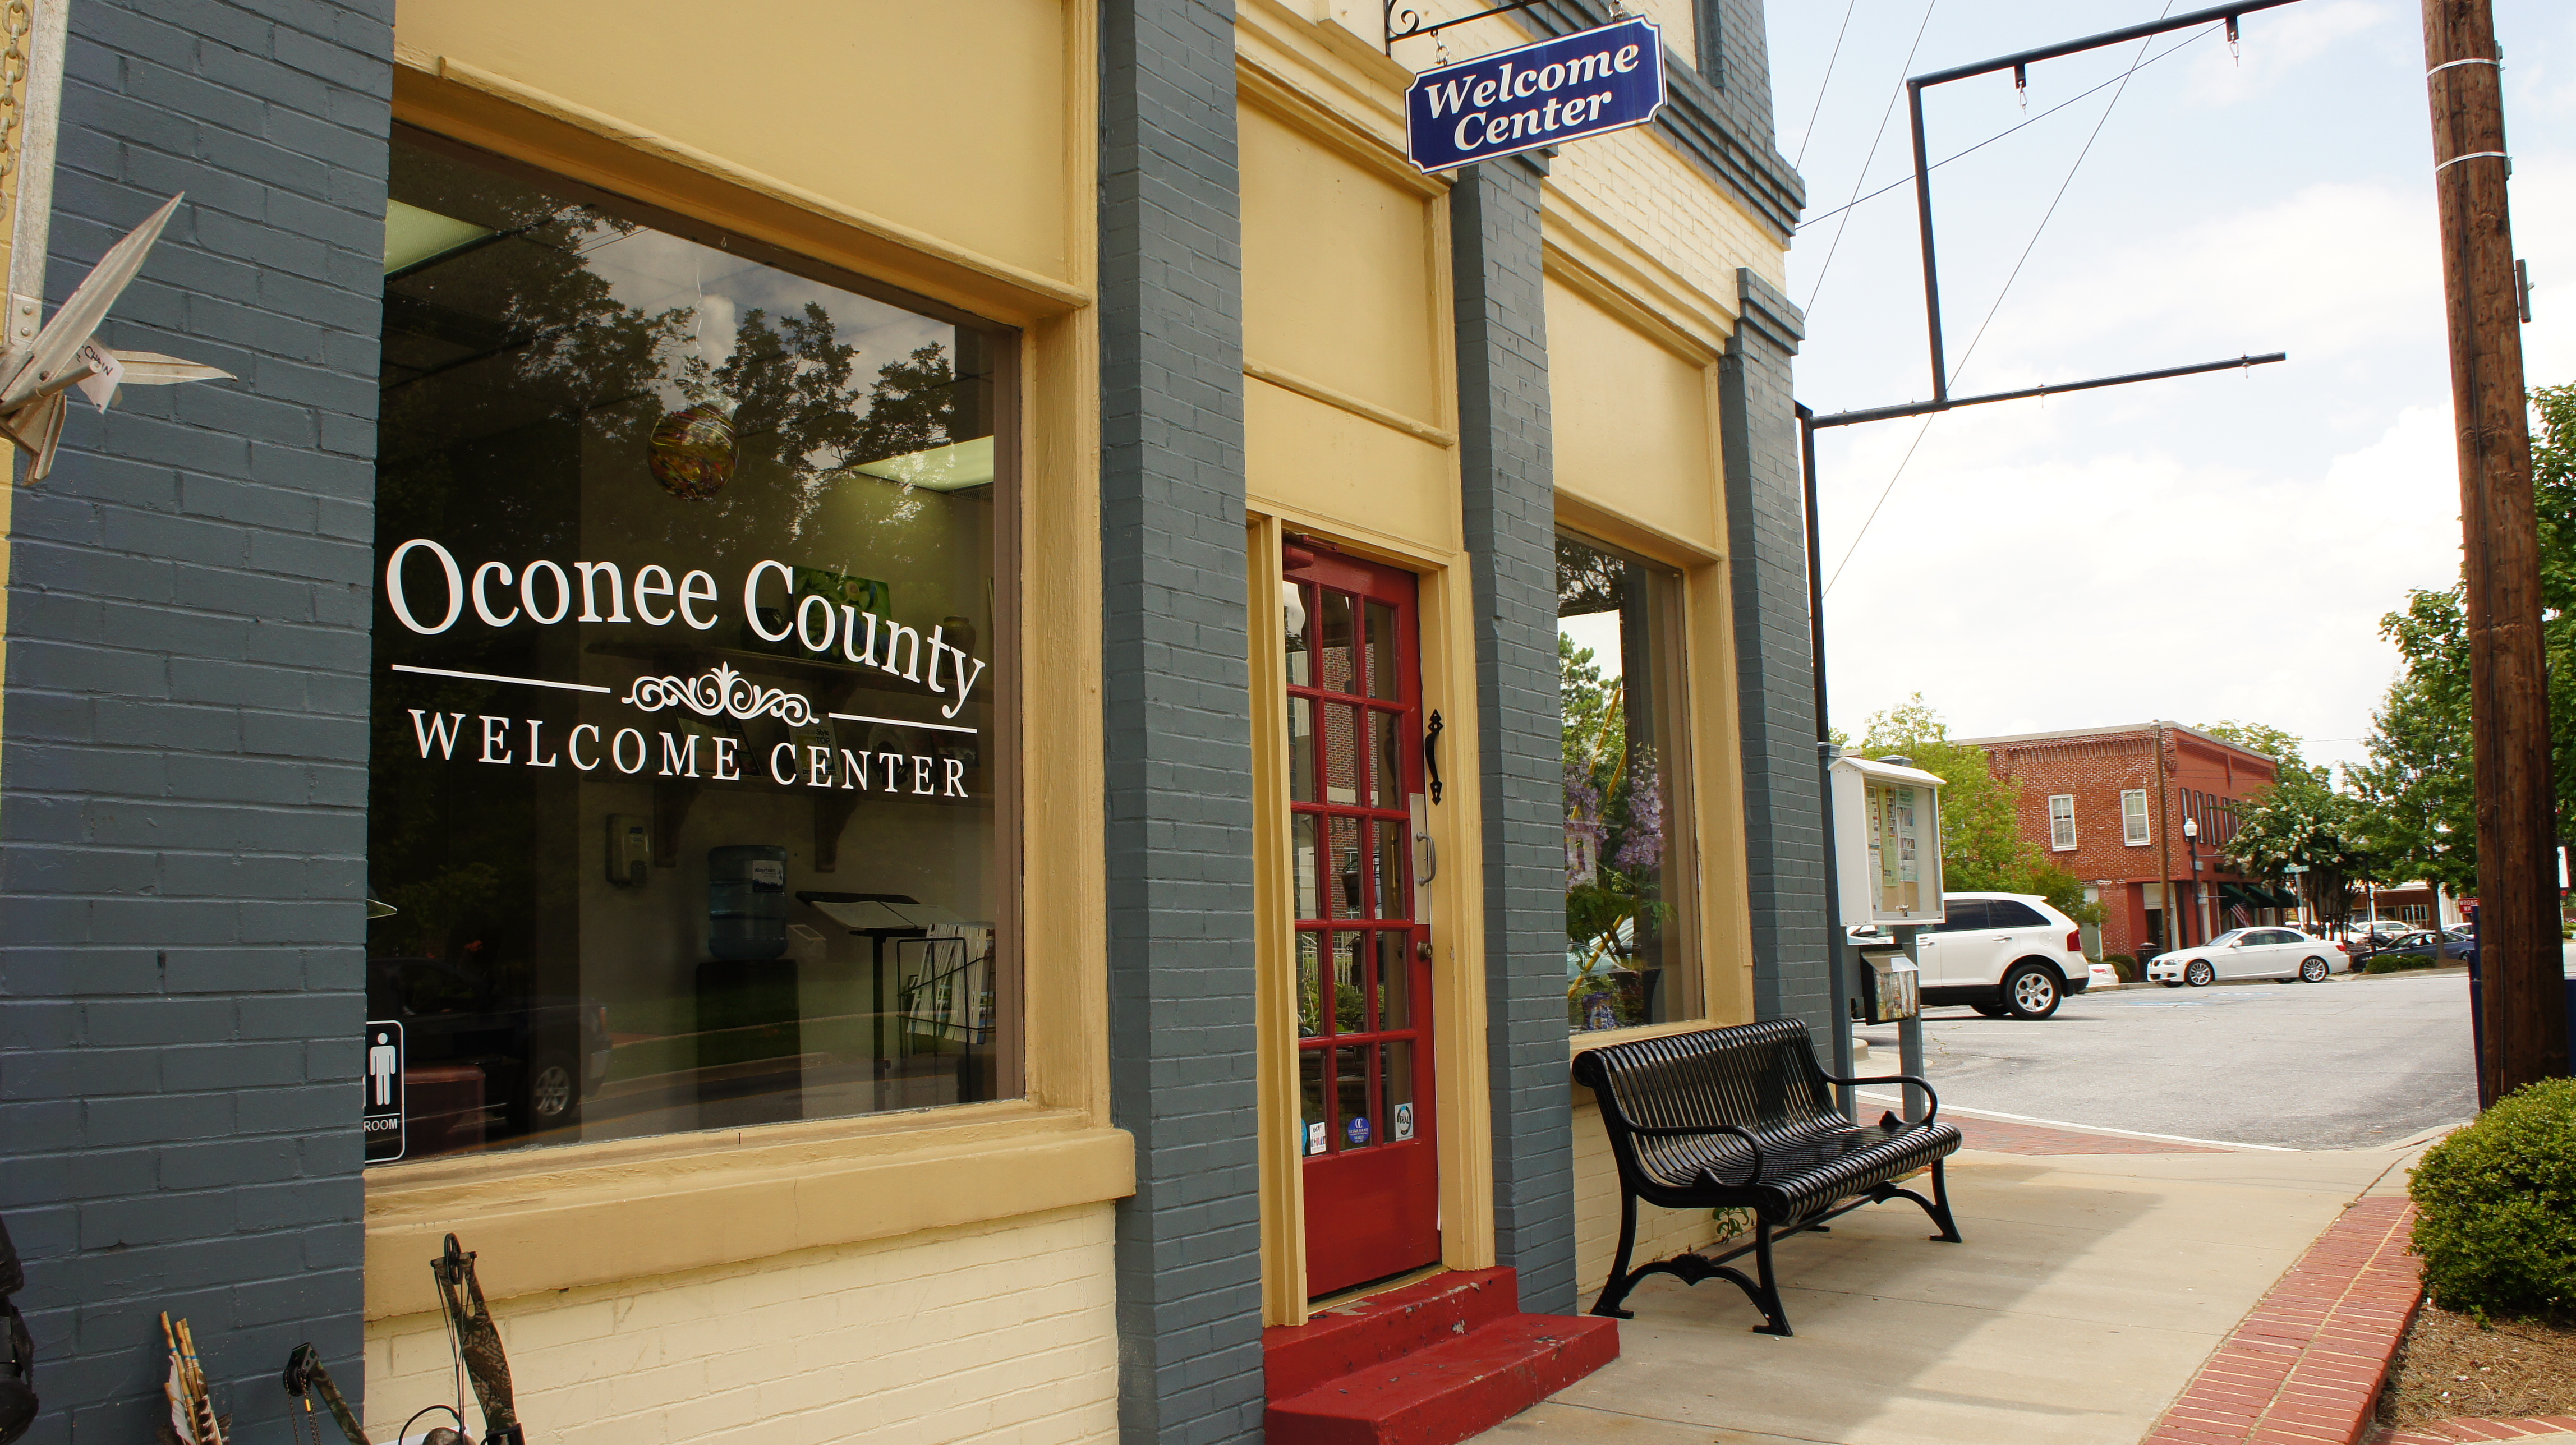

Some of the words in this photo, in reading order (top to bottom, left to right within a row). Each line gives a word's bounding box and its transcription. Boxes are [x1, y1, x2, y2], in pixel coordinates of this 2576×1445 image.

[1425, 44, 1639, 119] Welcome
[1454, 91, 1613, 151] Center
[387, 539, 719, 635] Oconee
[744, 560, 986, 719] County
[408, 709, 740, 781] WELCOME
[771, 742, 969, 798] CENTER
[364, 1118, 398, 1132] ROOM
